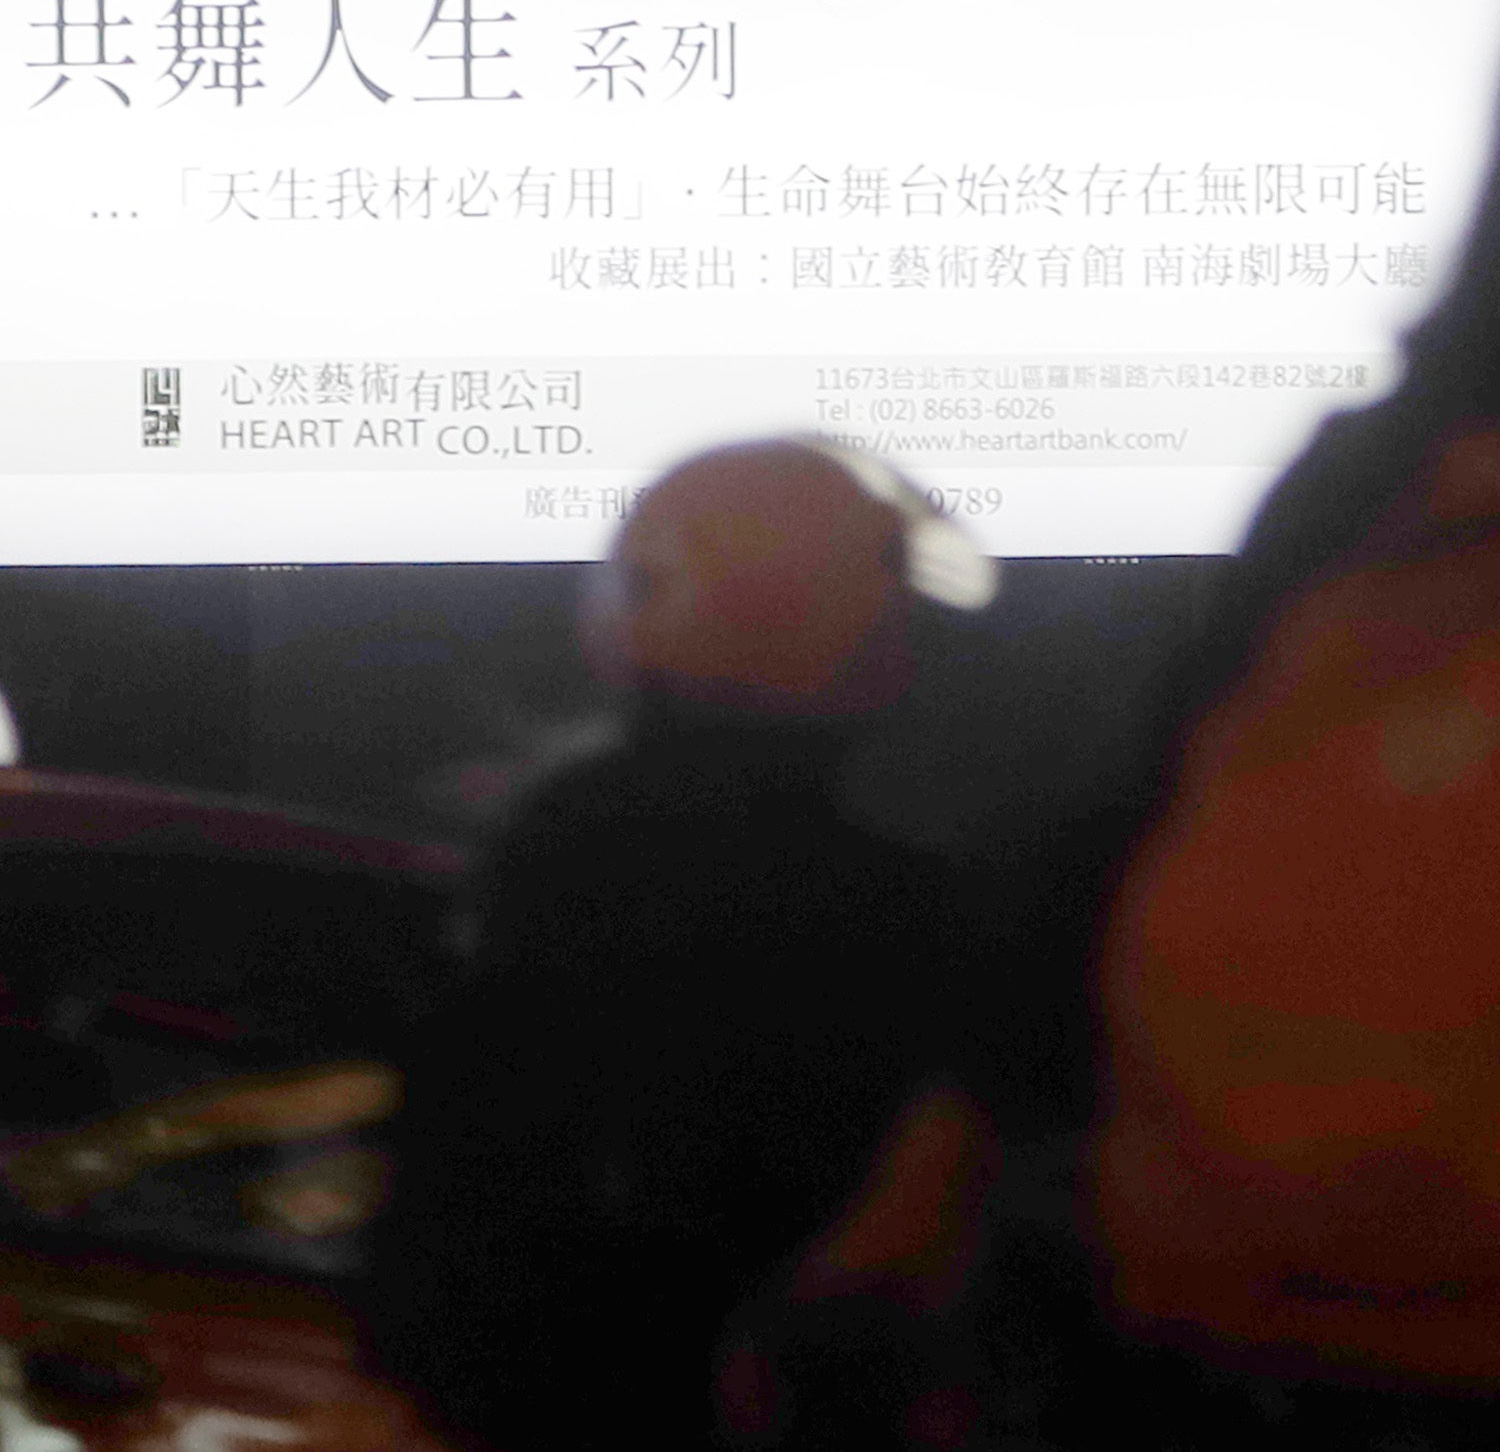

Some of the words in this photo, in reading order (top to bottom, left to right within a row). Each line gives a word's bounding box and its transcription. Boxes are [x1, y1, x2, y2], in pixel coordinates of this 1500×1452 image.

[573, 20, 738, 102] 系列
[220, 362, 583, 413] 心然藝術有限公司
[869, 398, 916, 426] (02)
[923, 398, 1056, 422] 8663-6026
[220, 419, 343, 452] HEART
[353, 418, 426, 450] ART
